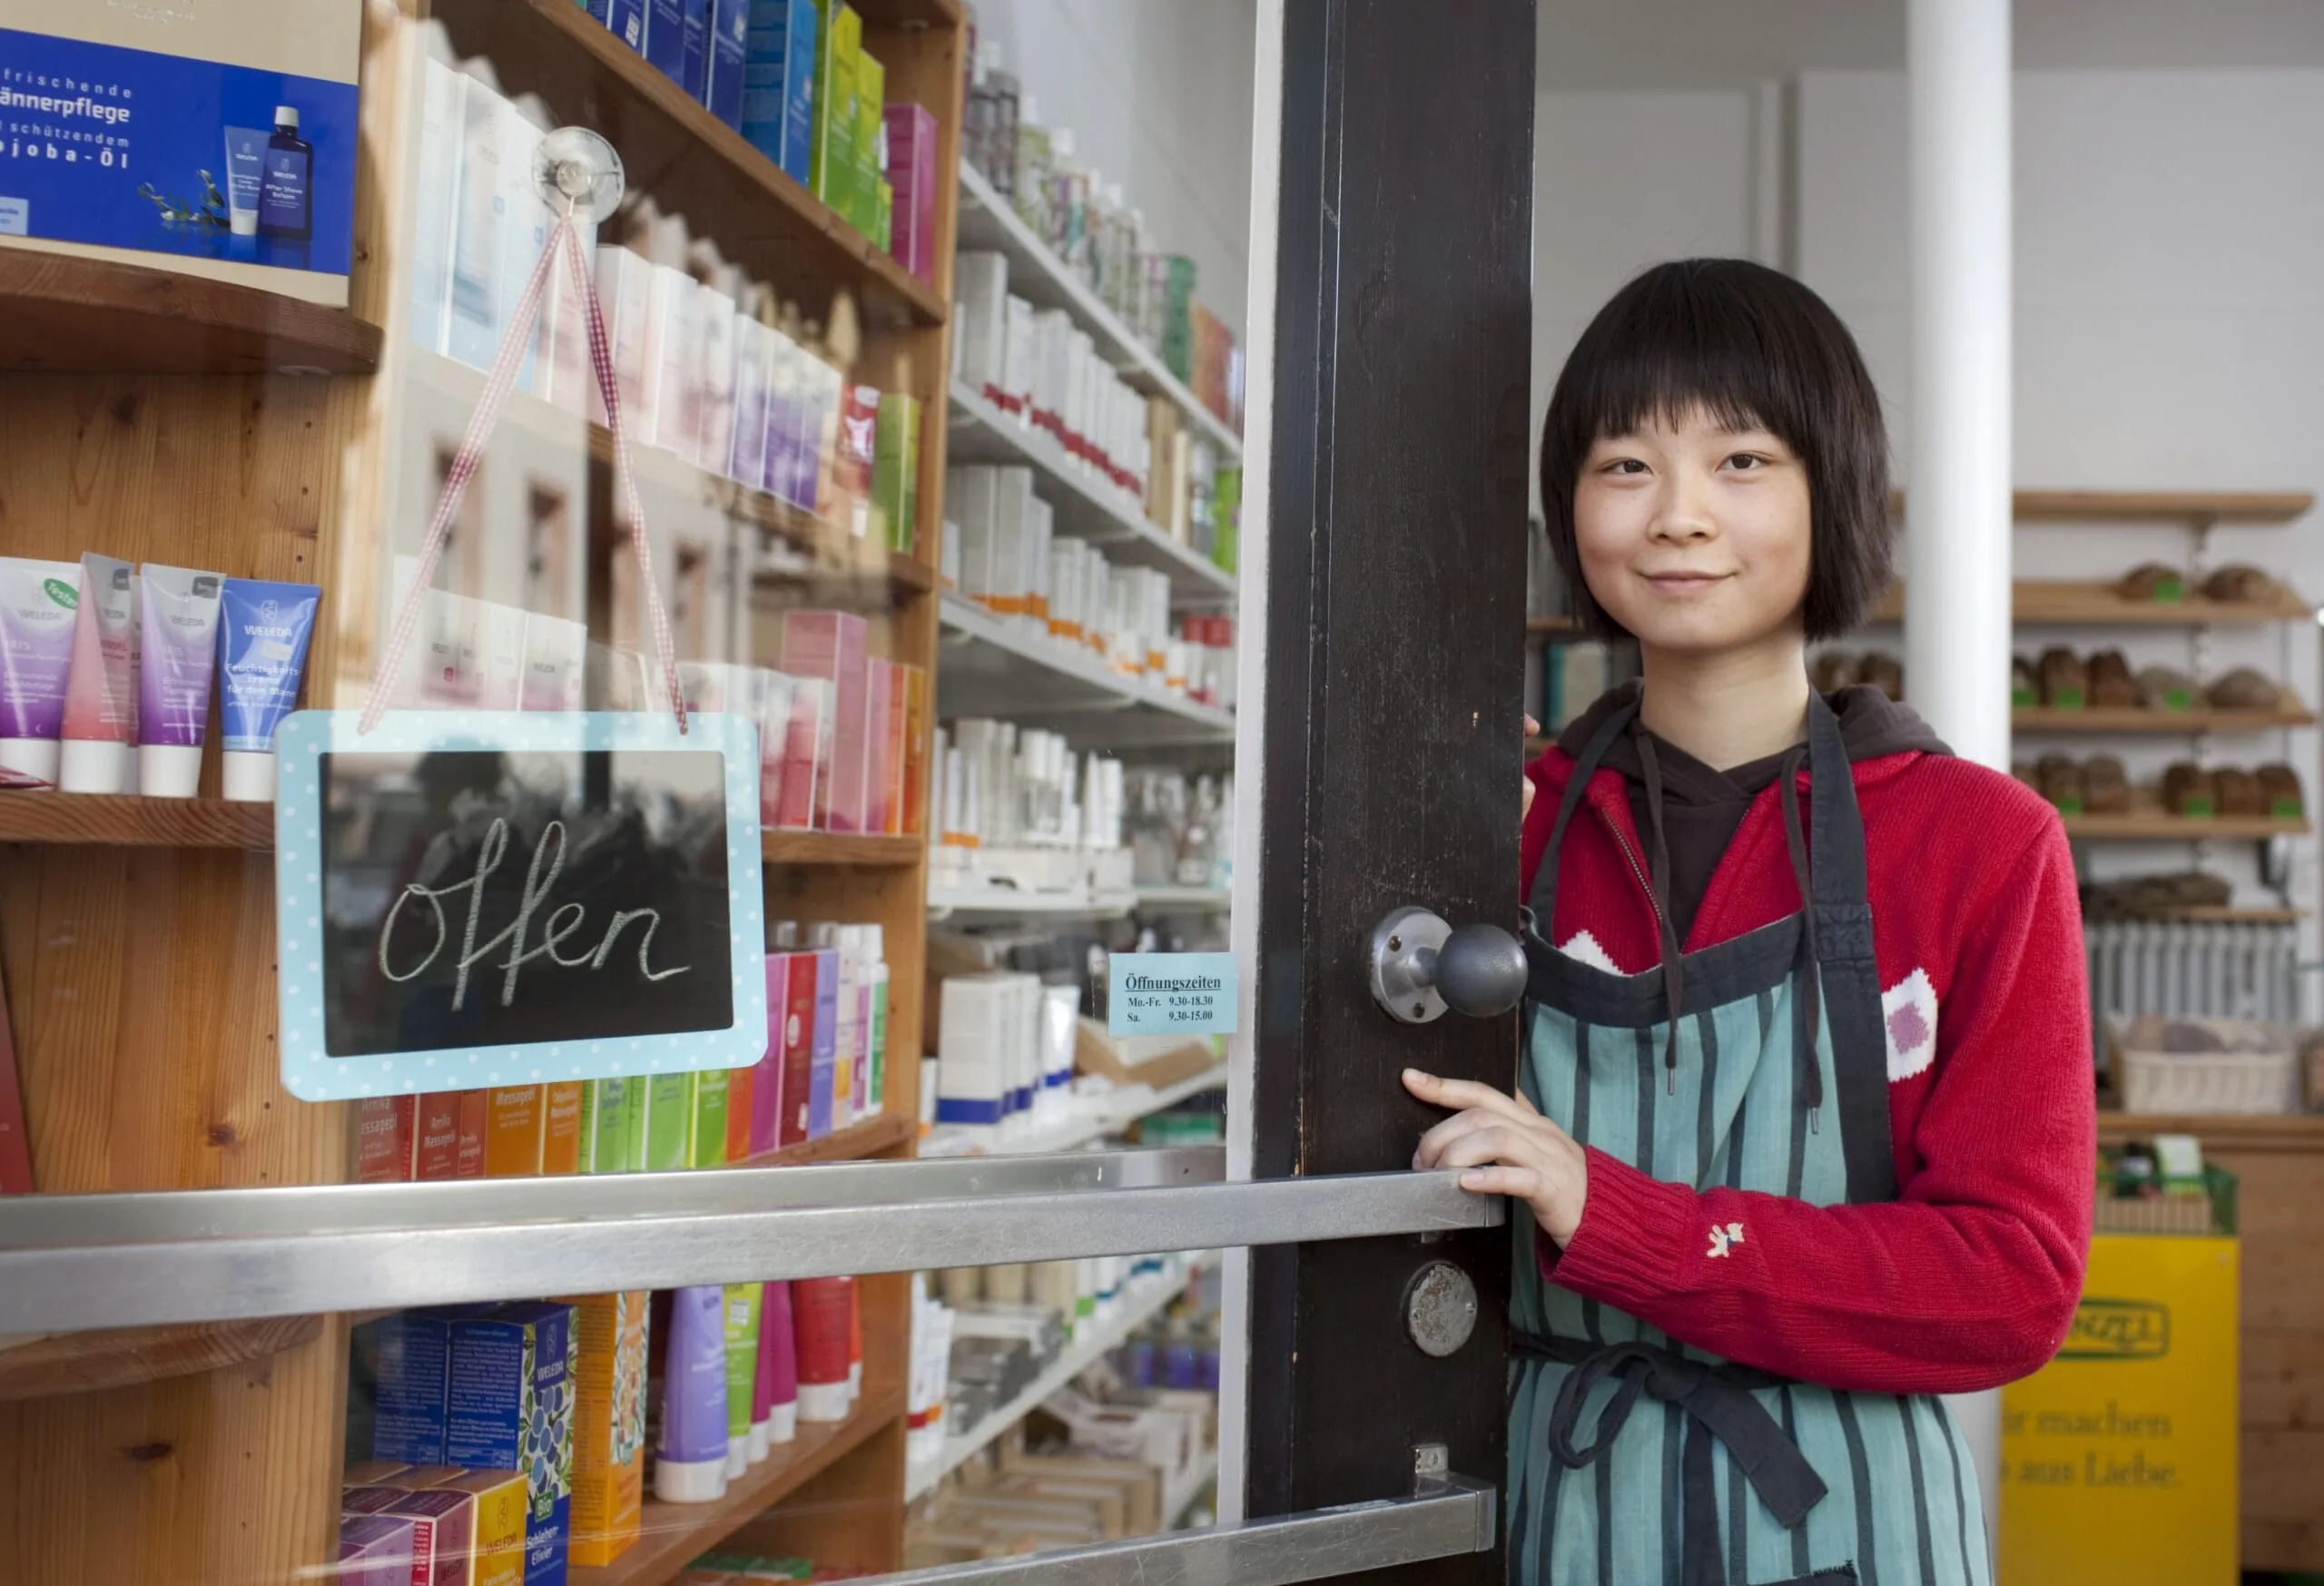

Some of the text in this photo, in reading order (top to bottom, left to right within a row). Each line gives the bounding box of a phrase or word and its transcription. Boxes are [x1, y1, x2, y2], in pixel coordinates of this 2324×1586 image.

[10, 123, 129, 148] schützendem
[17, 609, 63, 621] WELEDA
[244, 625, 292, 636] WELEDA
[226, 663, 301, 677] Feuchtigkeits-
[1125, 972, 1222, 992] Öffnungszeiten
[1128, 995, 1214, 1009] Mo.-Fr. 9.30-18.30
[1127, 1010, 1214, 1022] Sa. 9.30-15.00
[496, 1085, 536, 1107] Massageöl
[430, 1113, 452, 1129] Arnika
[423, 1129, 456, 1148] Massageöl
[537, 1360, 564, 1382] WELEDA
[486, 1532, 517, 1556] WELEDA
[526, 1525, 559, 1549] Schlehen-
[532, 1546, 553, 1566] Elixier
